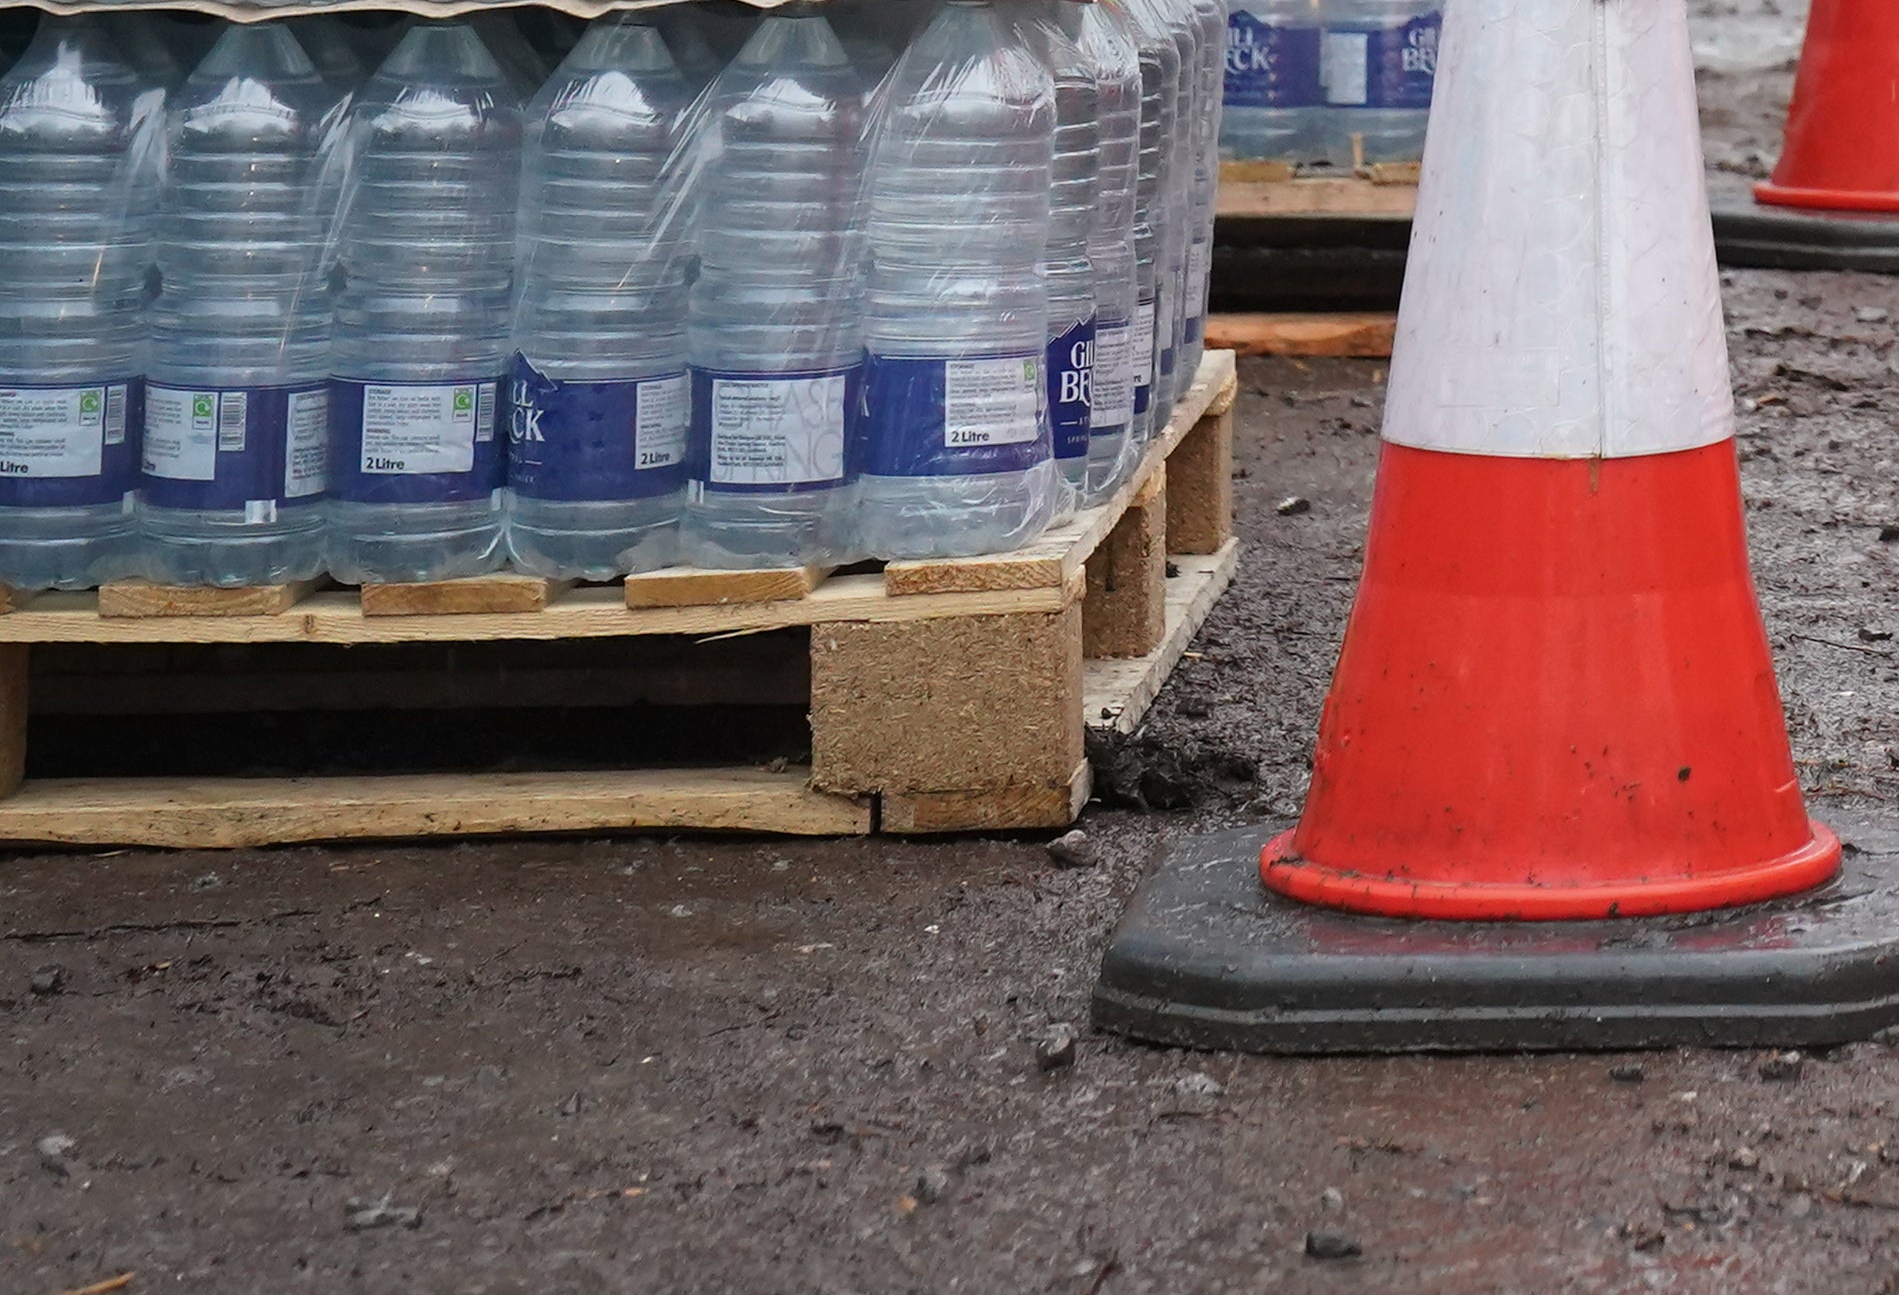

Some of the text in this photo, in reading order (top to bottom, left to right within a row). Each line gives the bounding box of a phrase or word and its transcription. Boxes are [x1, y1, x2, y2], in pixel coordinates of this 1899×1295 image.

[1071, 339, 1094, 369] GI
[1059, 369, 1091, 407] BE
[951, 430, 990, 443] 2 Litre
[366, 457, 405, 470] 2 Litre
[641, 452, 670, 465] 2 Litre
